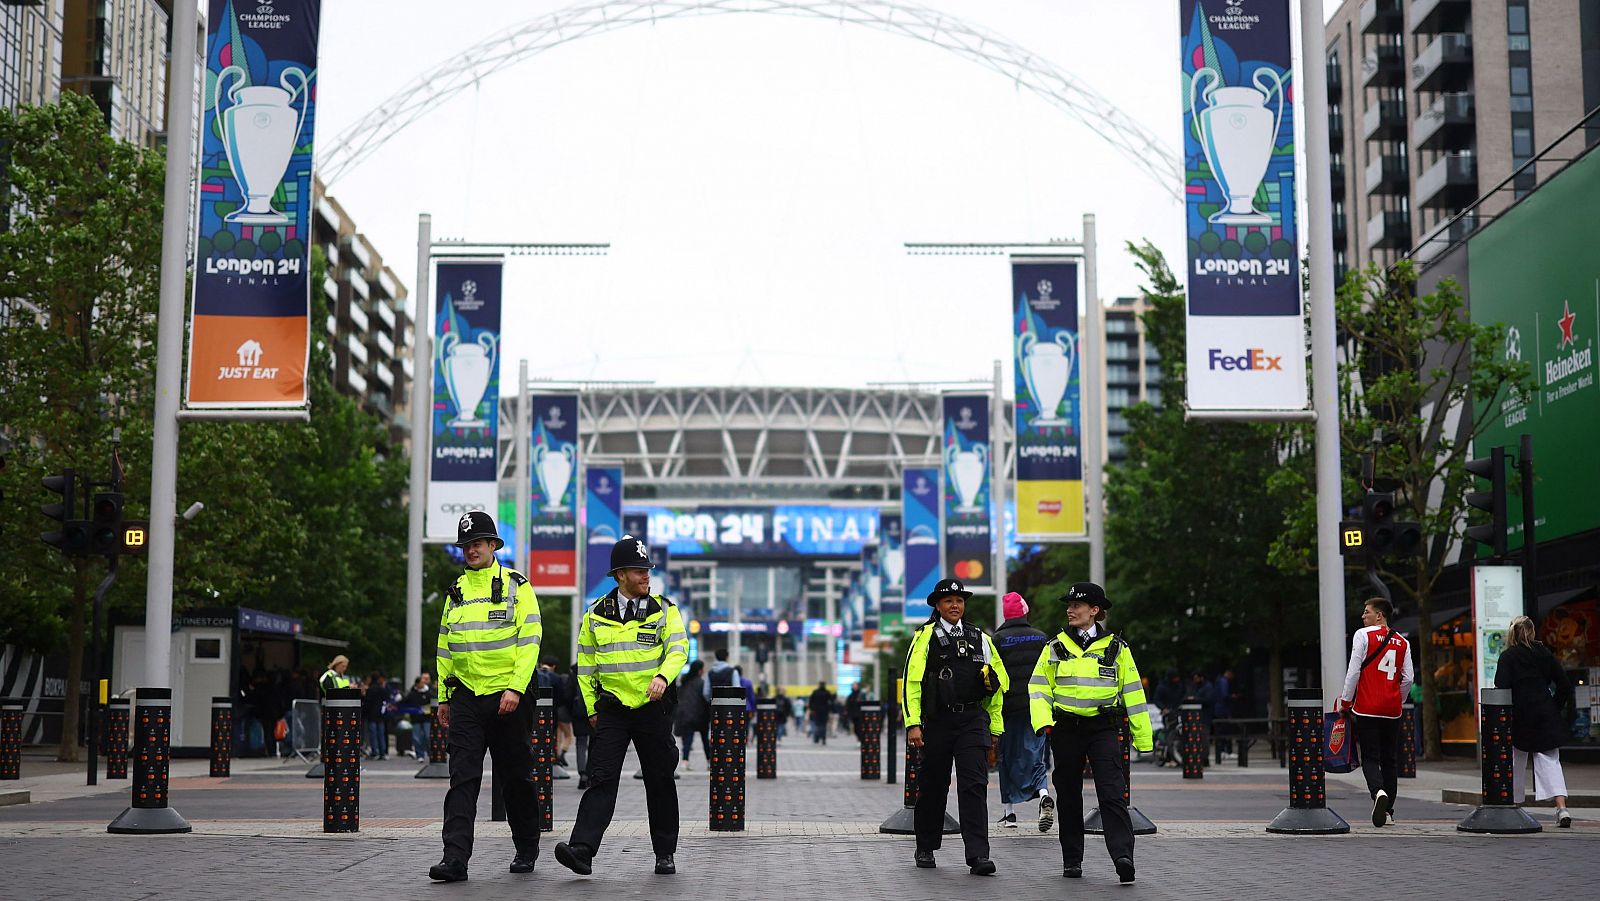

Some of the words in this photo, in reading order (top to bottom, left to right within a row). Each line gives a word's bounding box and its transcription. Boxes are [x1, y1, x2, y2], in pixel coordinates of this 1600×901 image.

[239, 14, 291, 23] CHAMPIONS
[248, 21, 282, 29] LEAGUE
[1209, 15, 1260, 24] CHAMPIONS
[1218, 22, 1251, 30] LEAGUE
[277, 258, 300, 275] 24
[1265, 258, 1290, 276] 24
[226, 277, 279, 285] FINAL
[1216, 277, 1268, 286] FINAL
[1208, 348, 1282, 371] FedEx
[217, 367, 250, 380] JUST
[252, 367, 279, 379] EAT
[1545, 348, 1593, 386] Heineken
[1559, 382, 1577, 399] Fresher
[1577, 372, 1592, 389] World
[1504, 408, 1528, 429] LEAGUE
[479, 446, 494, 459] 24
[1062, 445, 1077, 457] 24
[441, 503, 486, 514] oppo
[720, 513, 764, 544] 24
[125, 529, 145, 546] 03
[1344, 530, 1363, 546] 03
[1377, 649, 1397, 681] 4
